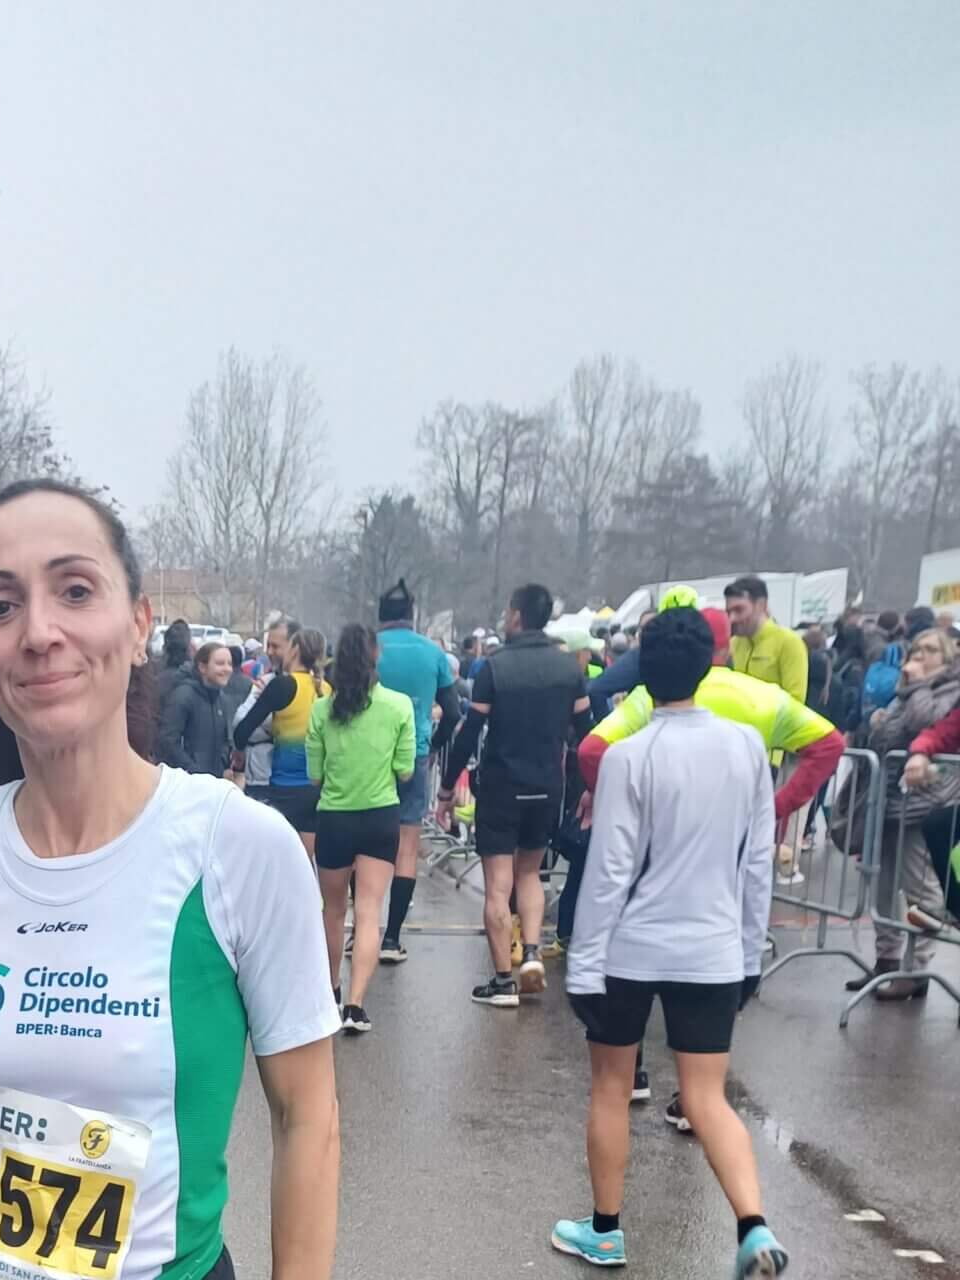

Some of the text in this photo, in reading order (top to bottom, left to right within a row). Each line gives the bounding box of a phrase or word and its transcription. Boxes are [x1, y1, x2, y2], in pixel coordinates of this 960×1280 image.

[23, 966, 109, 989] Circolo
[19, 992, 161, 1018] Dipendenti
[0, 1262, 9, 1273] DI
[12, 1266, 31, 1280] SAN
